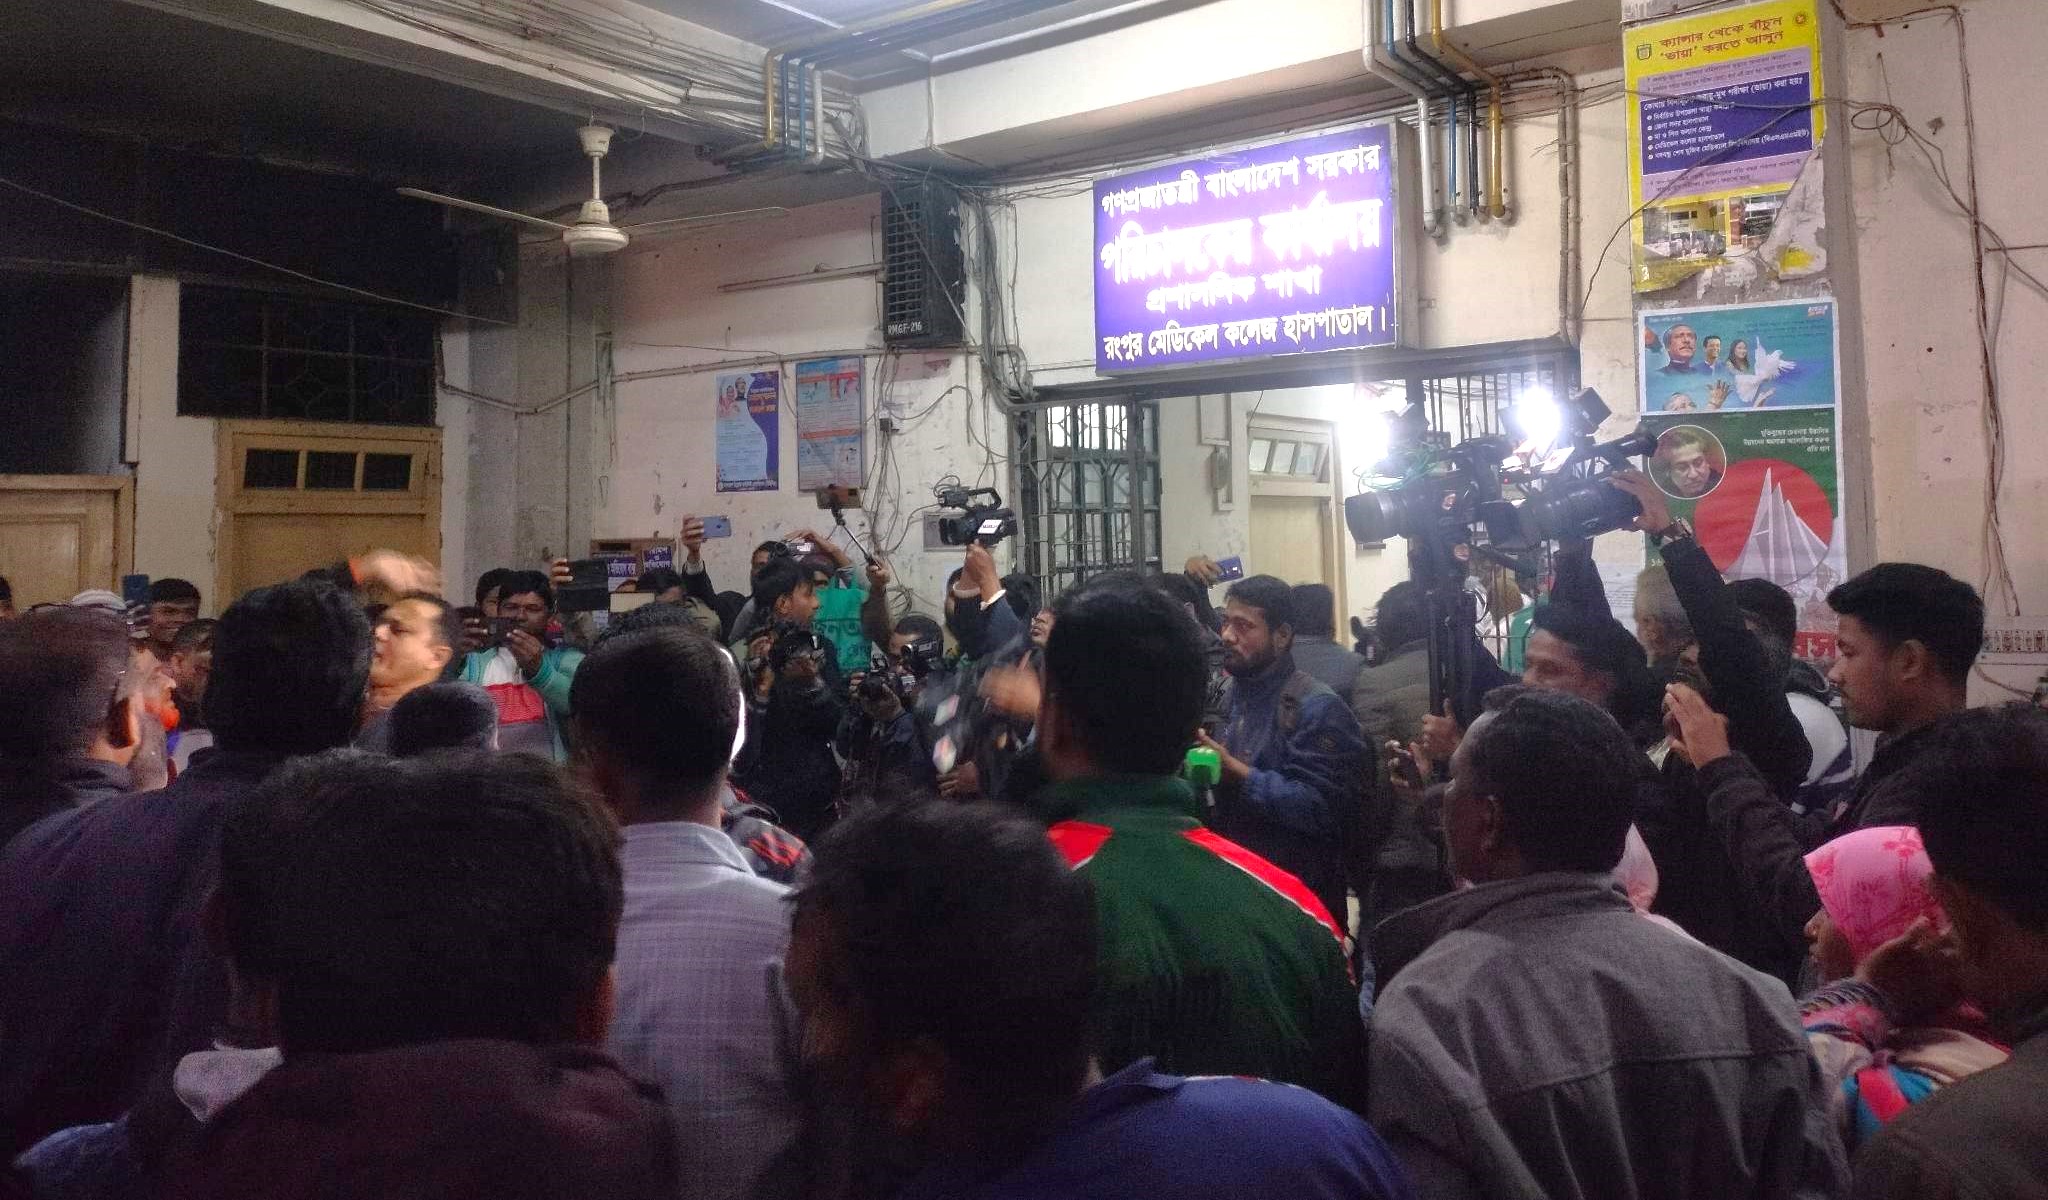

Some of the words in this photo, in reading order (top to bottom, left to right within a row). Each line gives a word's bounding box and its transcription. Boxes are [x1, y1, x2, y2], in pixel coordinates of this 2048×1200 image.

[1703, 39, 1741, 53] করতে
[1745, 30, 1784, 46] আসুন
[1708, 23, 1744, 41] থেকে
[1748, 15, 1783, 32] বাঁচুন
[1728, 86, 1749, 96] পরীক্ষা
[1774, 79, 1787, 87] করা
[1102, 170, 1200, 218] গণপ্রজাতন্ত্রী
[1205, 155, 1300, 199] বাংলাদেশ
[1304, 144, 1382, 181] সরকার
[1146, 270, 1257, 313] প্রশাসনিক
[1261, 264, 1323, 299] শাখা
[1103, 332, 1144, 362] রংপুর
[1148, 319, 1219, 357] মেডিকেল
[1222, 316, 1280, 347] কলেজ
[1283, 304, 1375, 345] হাসপাতাল
